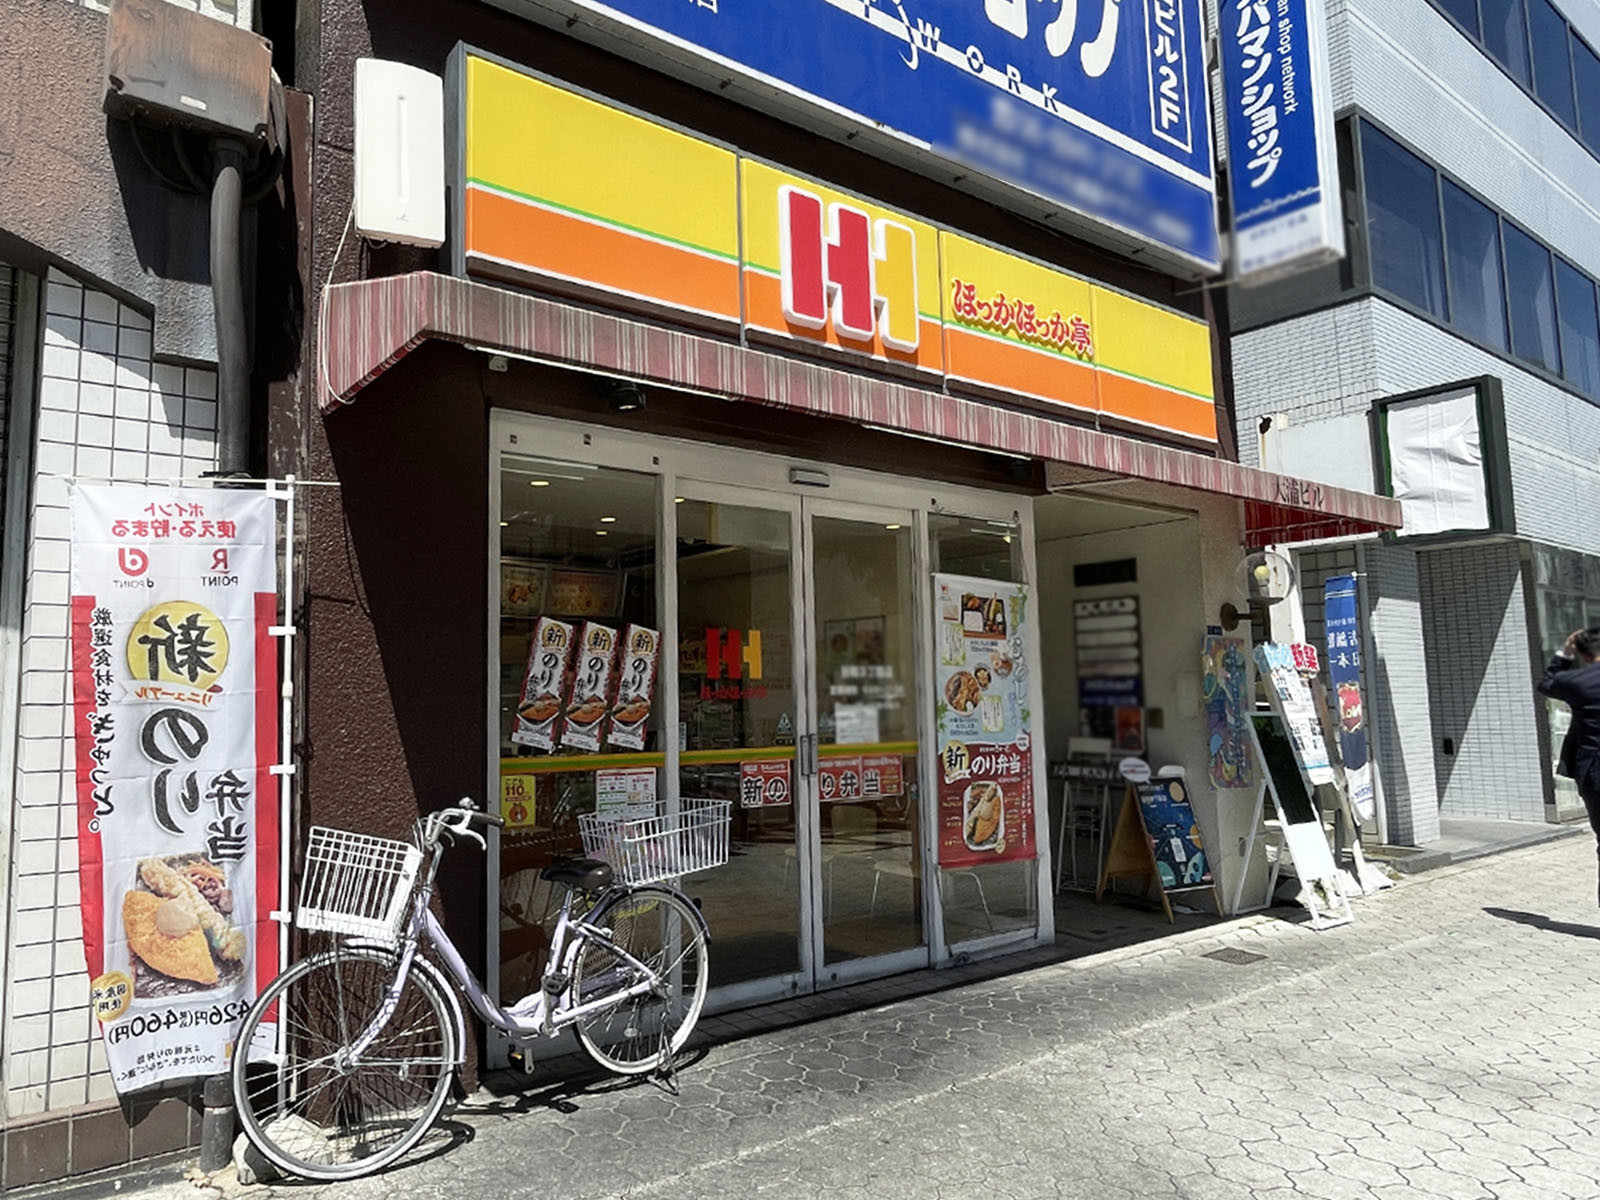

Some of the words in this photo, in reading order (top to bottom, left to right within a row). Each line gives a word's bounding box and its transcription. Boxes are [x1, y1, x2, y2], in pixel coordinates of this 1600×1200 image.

[1277, 17, 1293, 55] shop
[1236, 0, 1282, 188] パマンショップ
[1281, 56, 1299, 116] network
[952, 278, 1094, 356] ほっかほっか亭
[546, 627, 562, 645] 新
[592, 630, 607, 649] 新
[636, 632, 650, 652] 新
[540, 652, 558, 689] のり
[586, 656, 604, 691] のり
[631, 658, 647, 692] のり
[946, 746, 966, 771] 新
[971, 753, 1021, 775] のり弁当
[505, 785, 525, 796] 110
